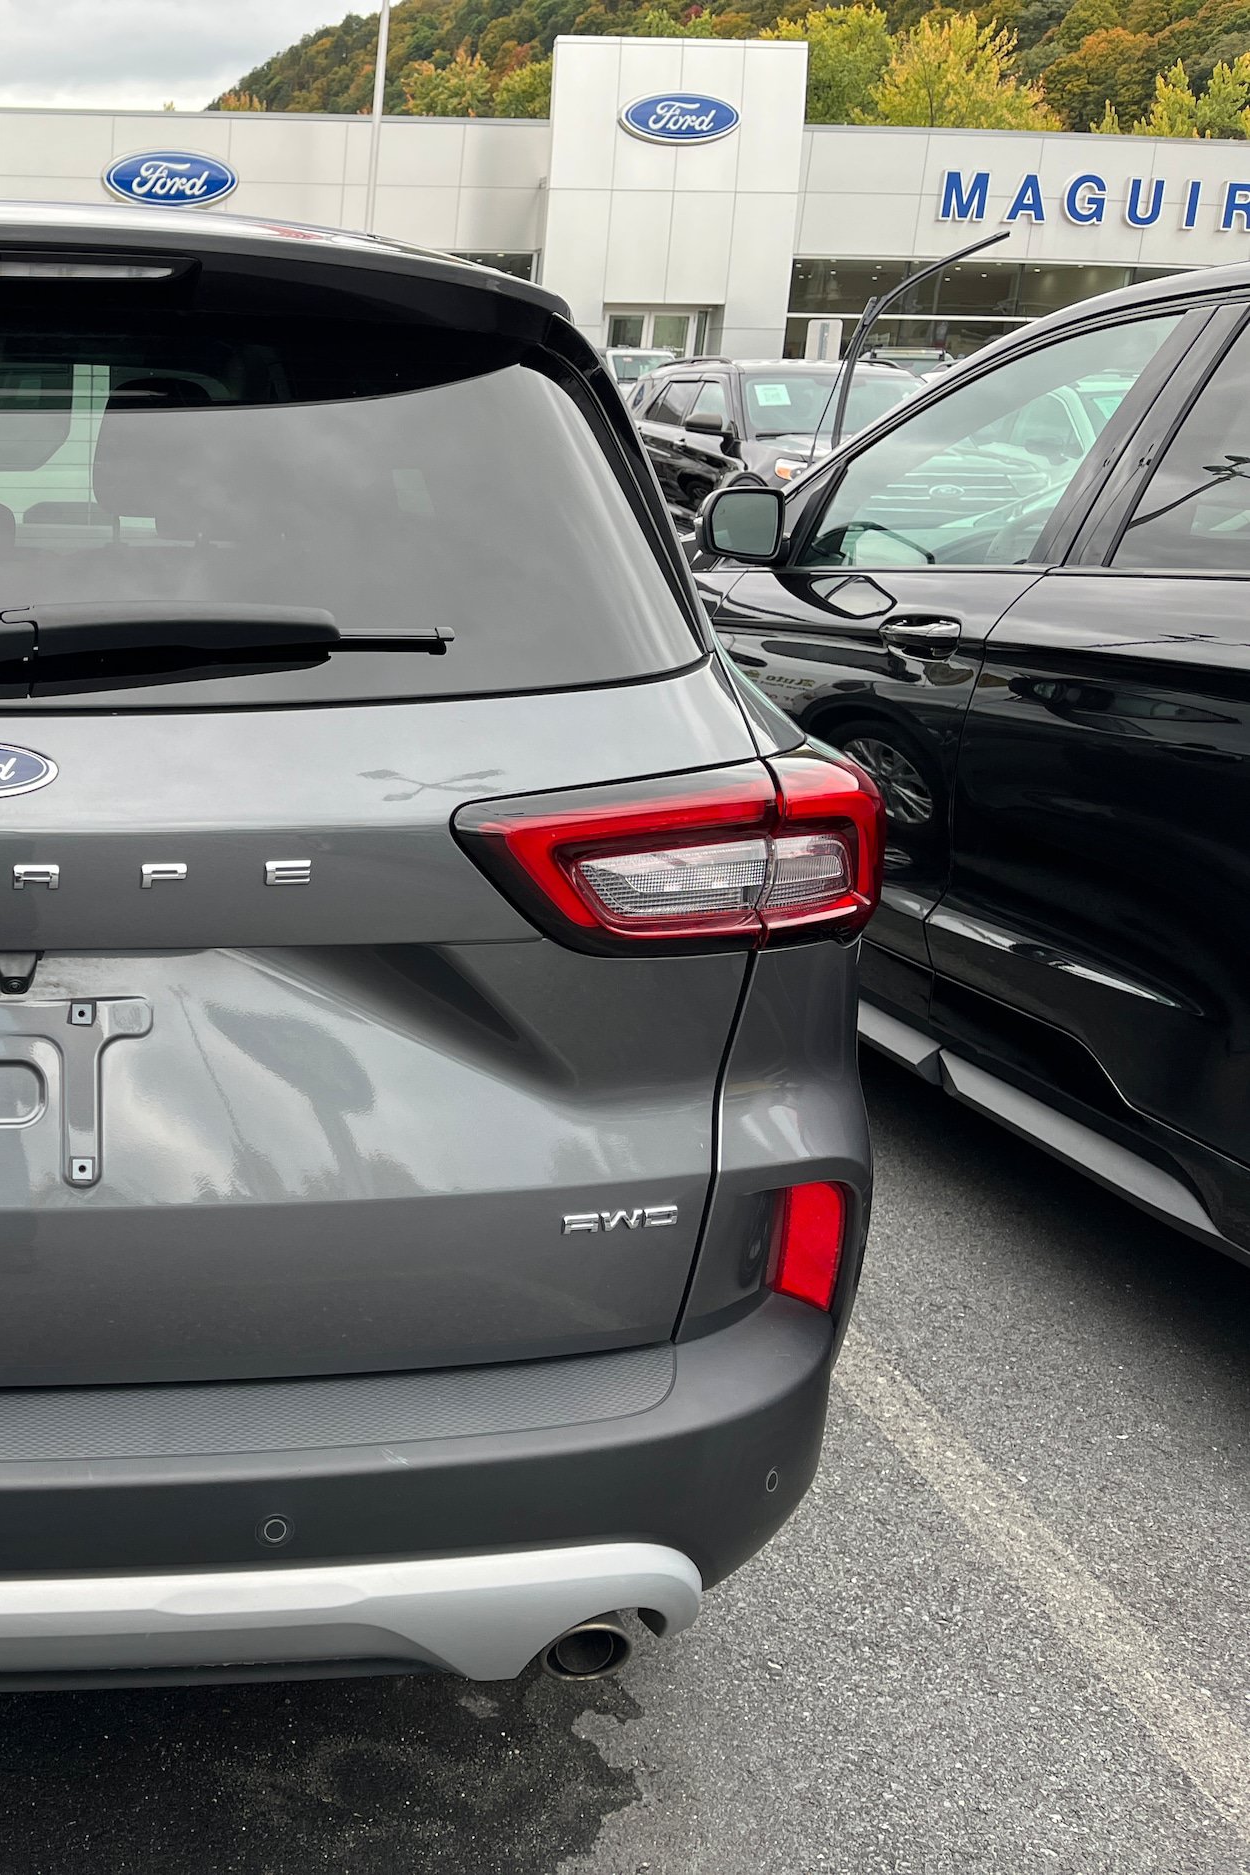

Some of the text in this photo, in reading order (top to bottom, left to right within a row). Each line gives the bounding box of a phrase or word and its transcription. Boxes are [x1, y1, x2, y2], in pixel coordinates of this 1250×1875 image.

[647, 100, 718, 132] Ford
[130, 160, 211, 196] Ford
[938, 169, 1250, 232] MAGUIR
[561, 1205, 679, 1235] AWD
